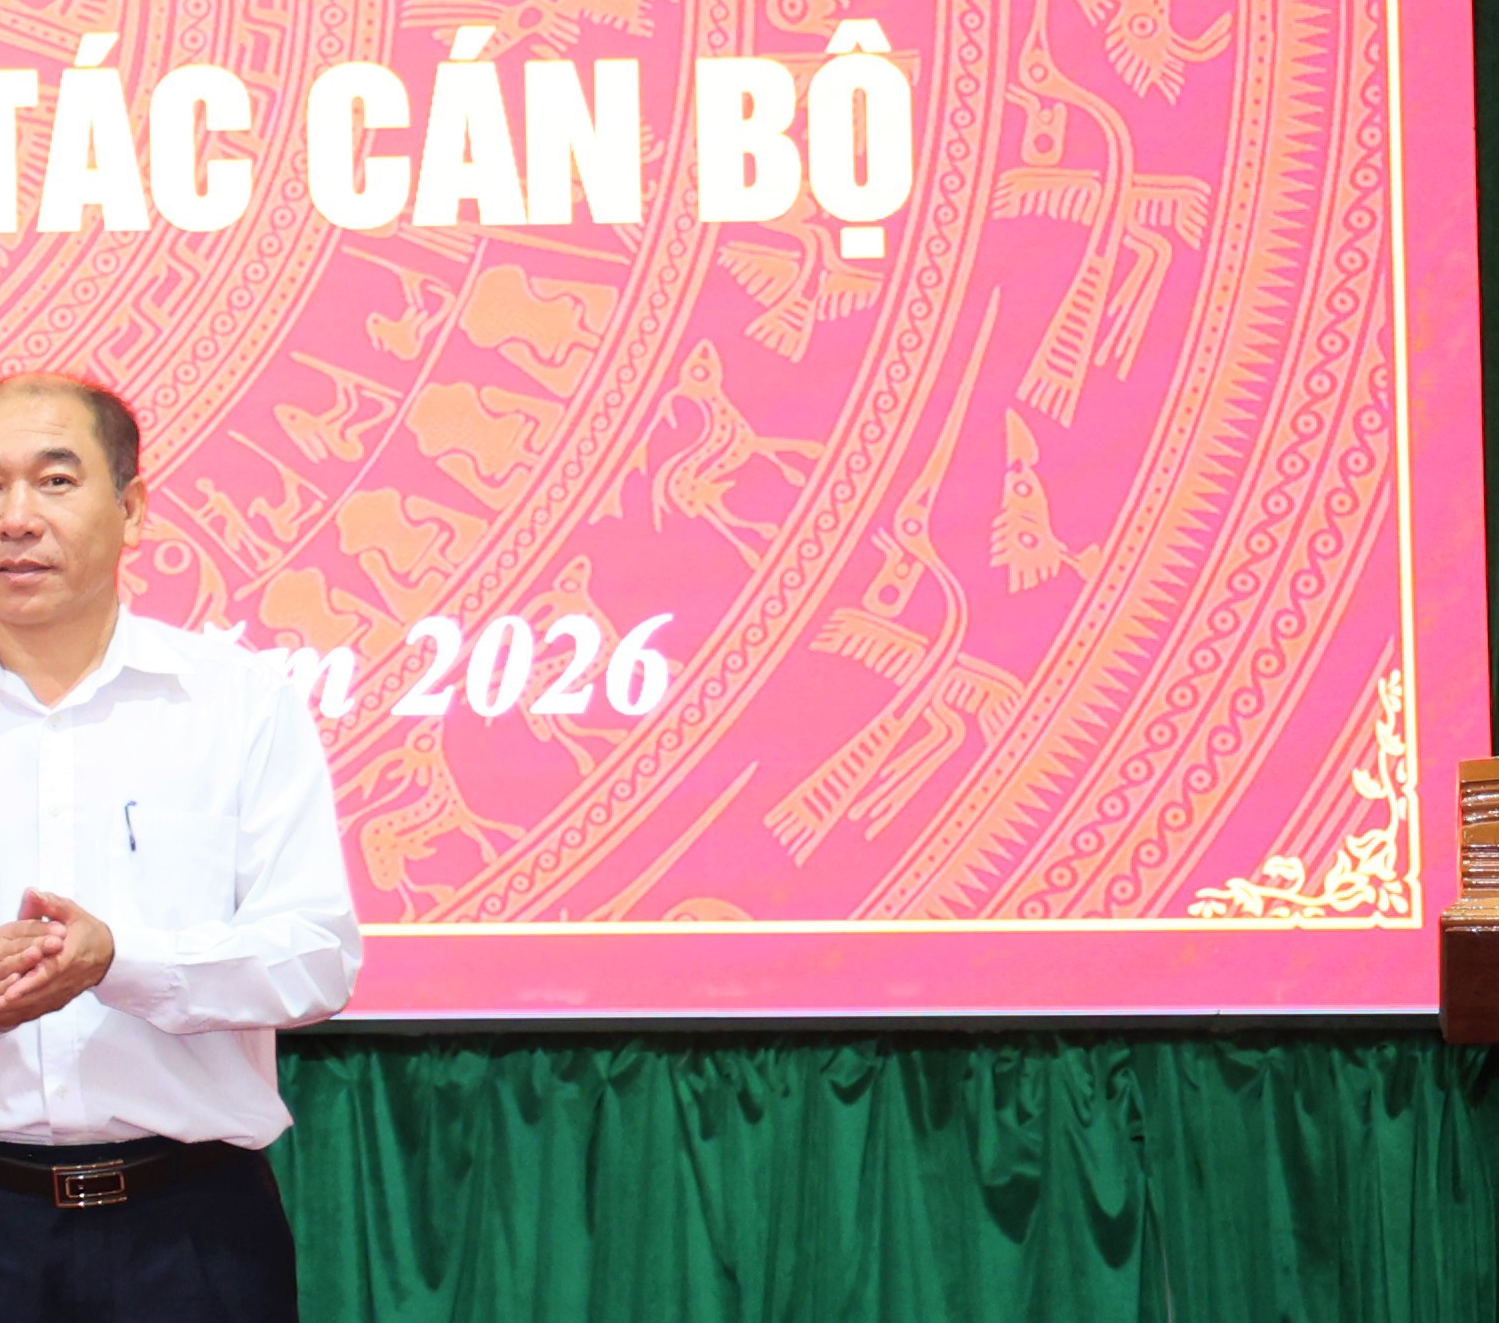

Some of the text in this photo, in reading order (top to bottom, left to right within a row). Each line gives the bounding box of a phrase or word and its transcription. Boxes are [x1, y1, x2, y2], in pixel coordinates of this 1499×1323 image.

[308, 28, 641, 228] CÁN
[698, 21, 912, 256] BỘ
[390, 614, 674, 717] 2026
